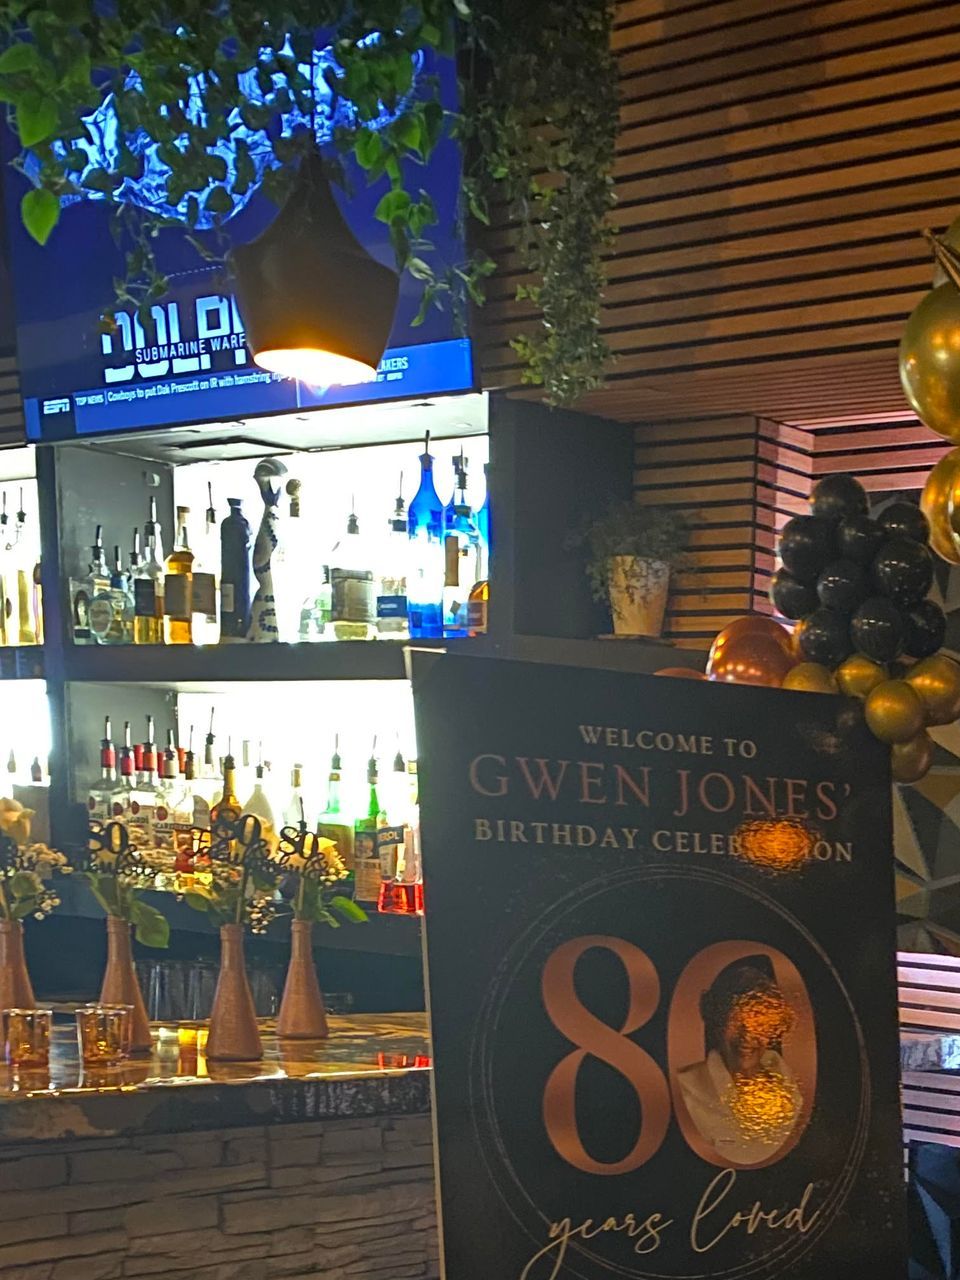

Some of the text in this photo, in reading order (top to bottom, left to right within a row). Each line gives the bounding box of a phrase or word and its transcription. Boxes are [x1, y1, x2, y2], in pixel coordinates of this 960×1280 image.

[101, 294, 245, 383] DOLP
[135, 339, 206, 363] SUBMARINE
[377, 357, 409, 371] AKERS
[108, 390, 136, 401] Cowboys
[136, 388, 144, 398] to
[145, 386, 156, 399] put
[157, 384, 170, 395] Dak
[171, 380, 199, 393] Prescott
[200, 381, 209, 390] on
[218, 376, 234, 387] with
[234, 372, 271, 384] hamstring
[43, 398, 70, 414] ESPN
[577, 724, 758, 759] WELCOME TO
[469, 753, 851, 821] GWEN JONES'
[279, 826, 319, 859] 80
[474, 818, 853, 862] BIRTHDAY CELEBON
[541, 934, 818, 1176] 80
[690, 1167, 820, 1253] loved
